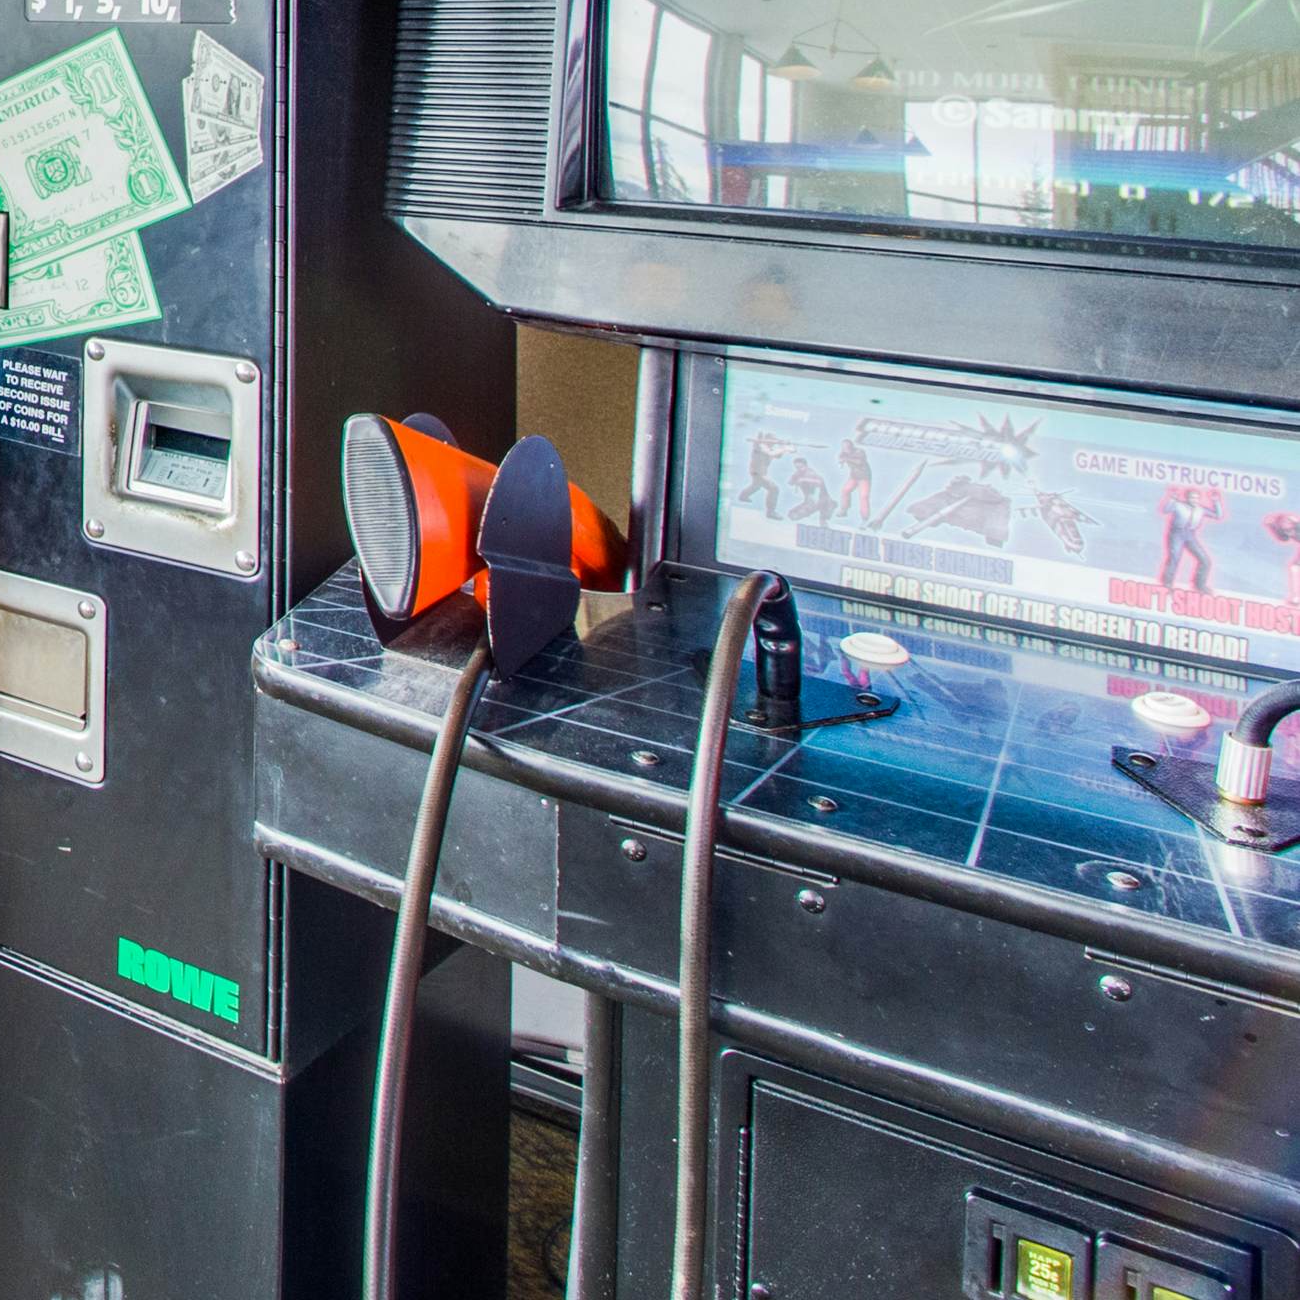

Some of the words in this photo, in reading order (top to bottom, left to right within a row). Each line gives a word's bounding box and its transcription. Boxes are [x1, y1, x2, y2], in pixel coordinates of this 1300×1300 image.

[983, 97, 1142, 143] Sammy
[2, 359, 41, 377] PLEASE
[42, 367, 68, 382] WAIT
[5, 373, 19, 385] TO
[20, 377, 64, 396] RECEIVE
[13, 404, 45, 420] COINS
[46, 411, 69, 425] FOR
[40, 395, 71, 412] ISSUE
[0, 414, 9, 425] A
[10, 416, 40, 433] $10.00
[41, 424, 65, 439] BILL
[1075, 452, 1128, 475] GAME
[1135, 459, 1282, 497] INSTRUCTIONS
[796, 523, 852, 557] DEFEAT
[852, 532, 881, 562] ALL
[882, 538, 934, 572] THESE
[841, 564, 893, 596] PUMP
[894, 574, 921, 602] OR
[922, 580, 984, 614] SHOOT
[984, 590, 1019, 620] OFF
[1021, 598, 1056, 628] THE
[1057, 604, 1132, 644] SCREEN
[1133, 617, 1162, 647] TO
[1163, 623, 1249, 664] RELOAD!
[1108, 577, 1170, 614] DON'T
[1172, 587, 1244, 626] SHOOT
[117, 936, 240, 1024] ROWE
[1029, 1259, 1059, 1283] 25¢
